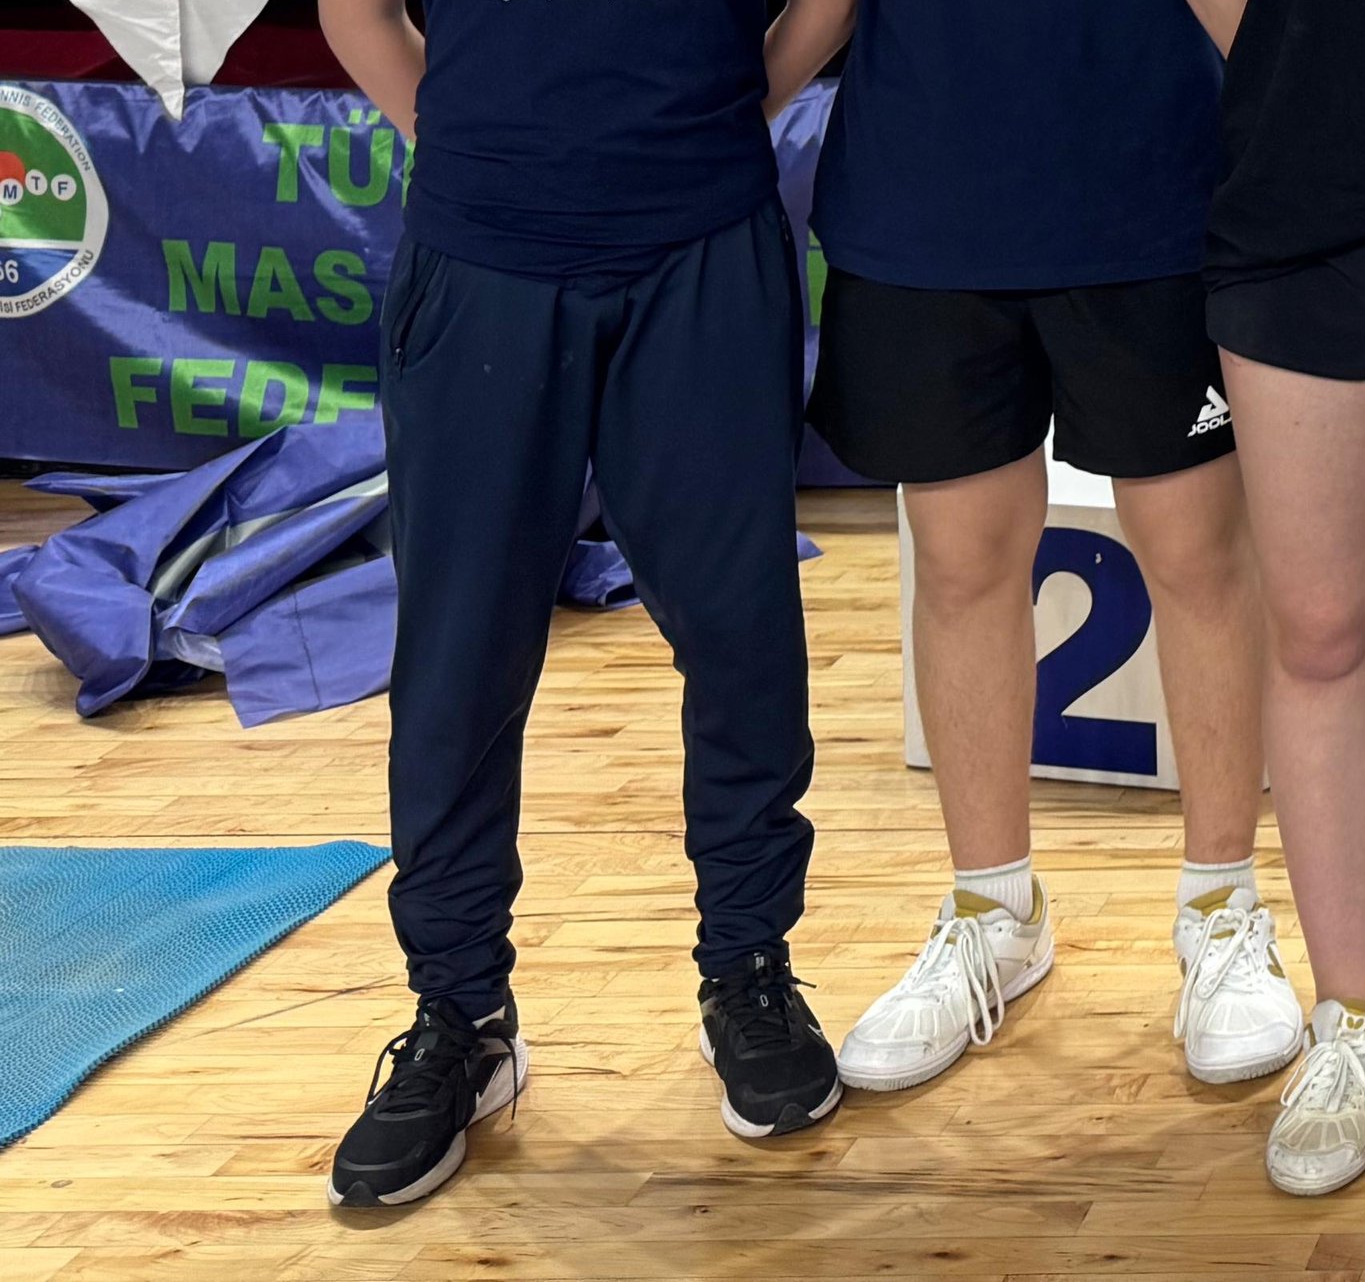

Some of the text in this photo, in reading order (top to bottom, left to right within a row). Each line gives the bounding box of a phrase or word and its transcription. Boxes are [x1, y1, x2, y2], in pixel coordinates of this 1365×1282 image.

[1, 89, 91, 172] NNIS FEDERATION
[15, 249, 94, 313] FEDERASYONU
[162, 239, 374, 325] MAS
[1187, 415, 1232, 437] JOOL
[1030, 526, 1158, 777] 2
